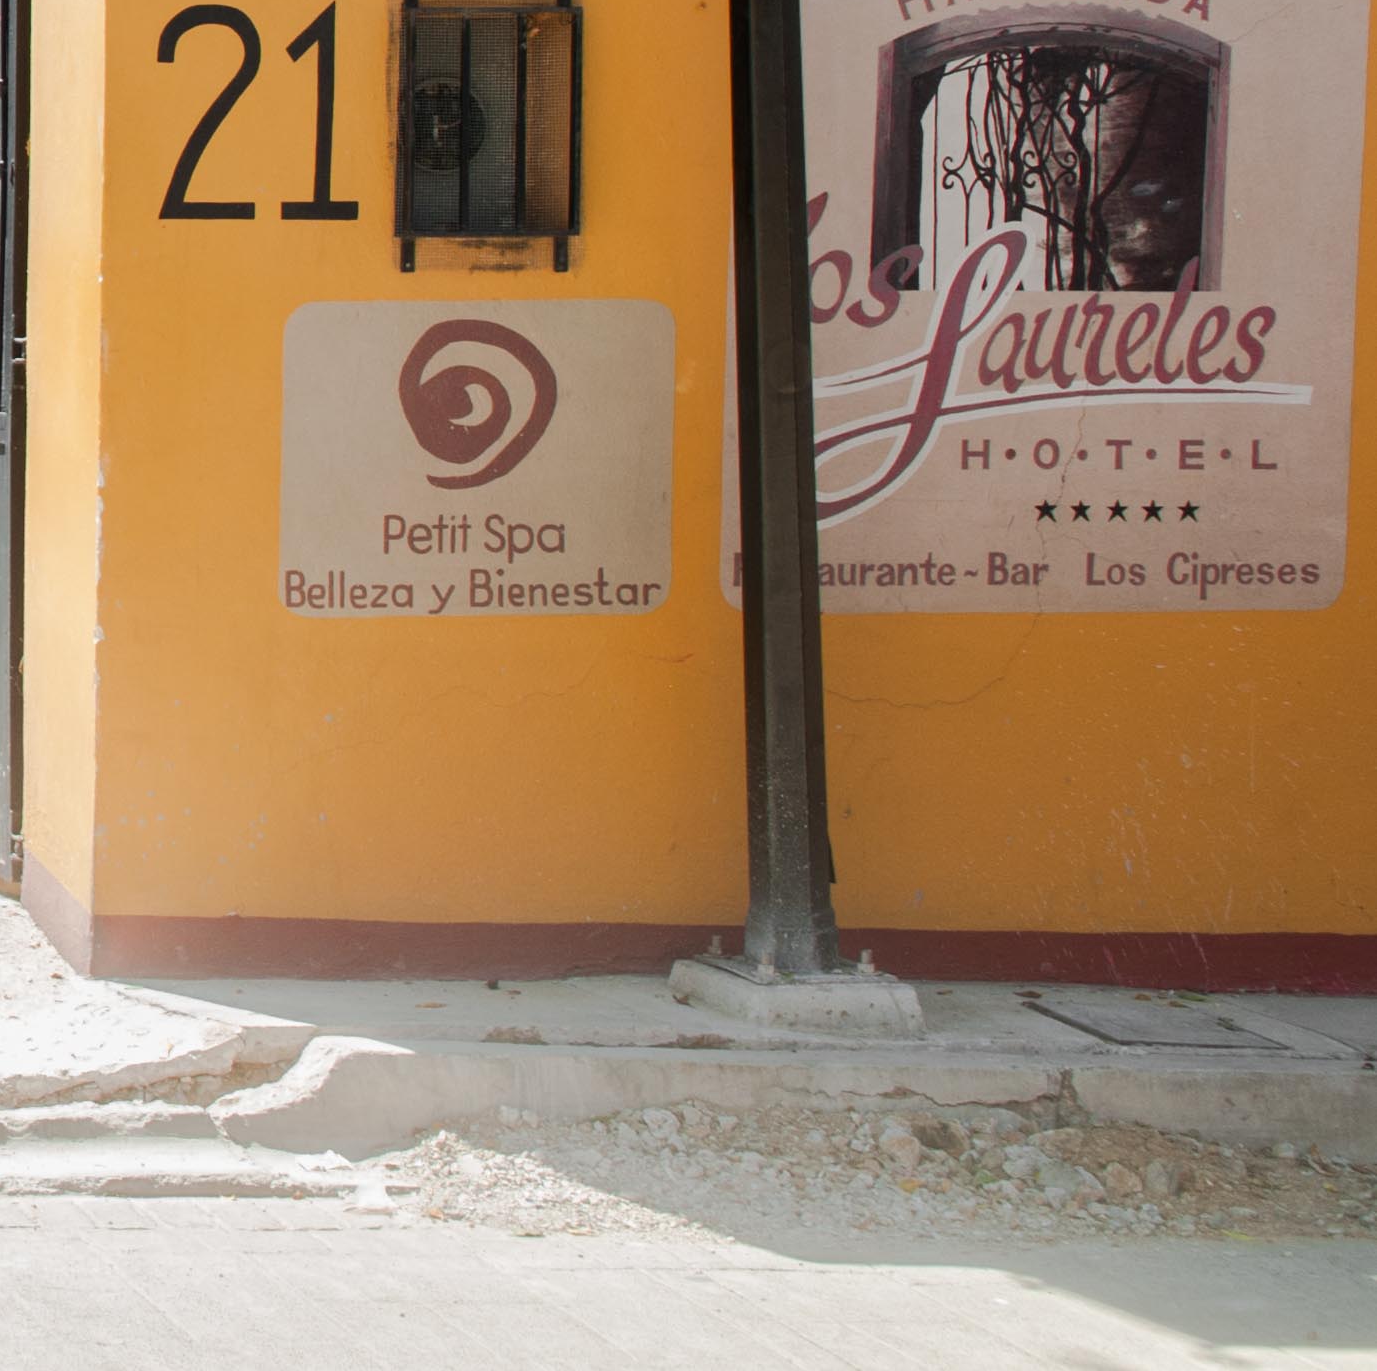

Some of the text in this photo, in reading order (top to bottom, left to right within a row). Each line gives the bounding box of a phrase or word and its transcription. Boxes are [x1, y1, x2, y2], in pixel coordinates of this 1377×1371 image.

[156, 0, 360, 222] 21
[383, 513, 566, 564] Petit Spa
[284, 566, 662, 615] Belleza y Bienestar
[1085, 551, 1147, 587] Los
[1166, 551, 1321, 601] Cipreses
